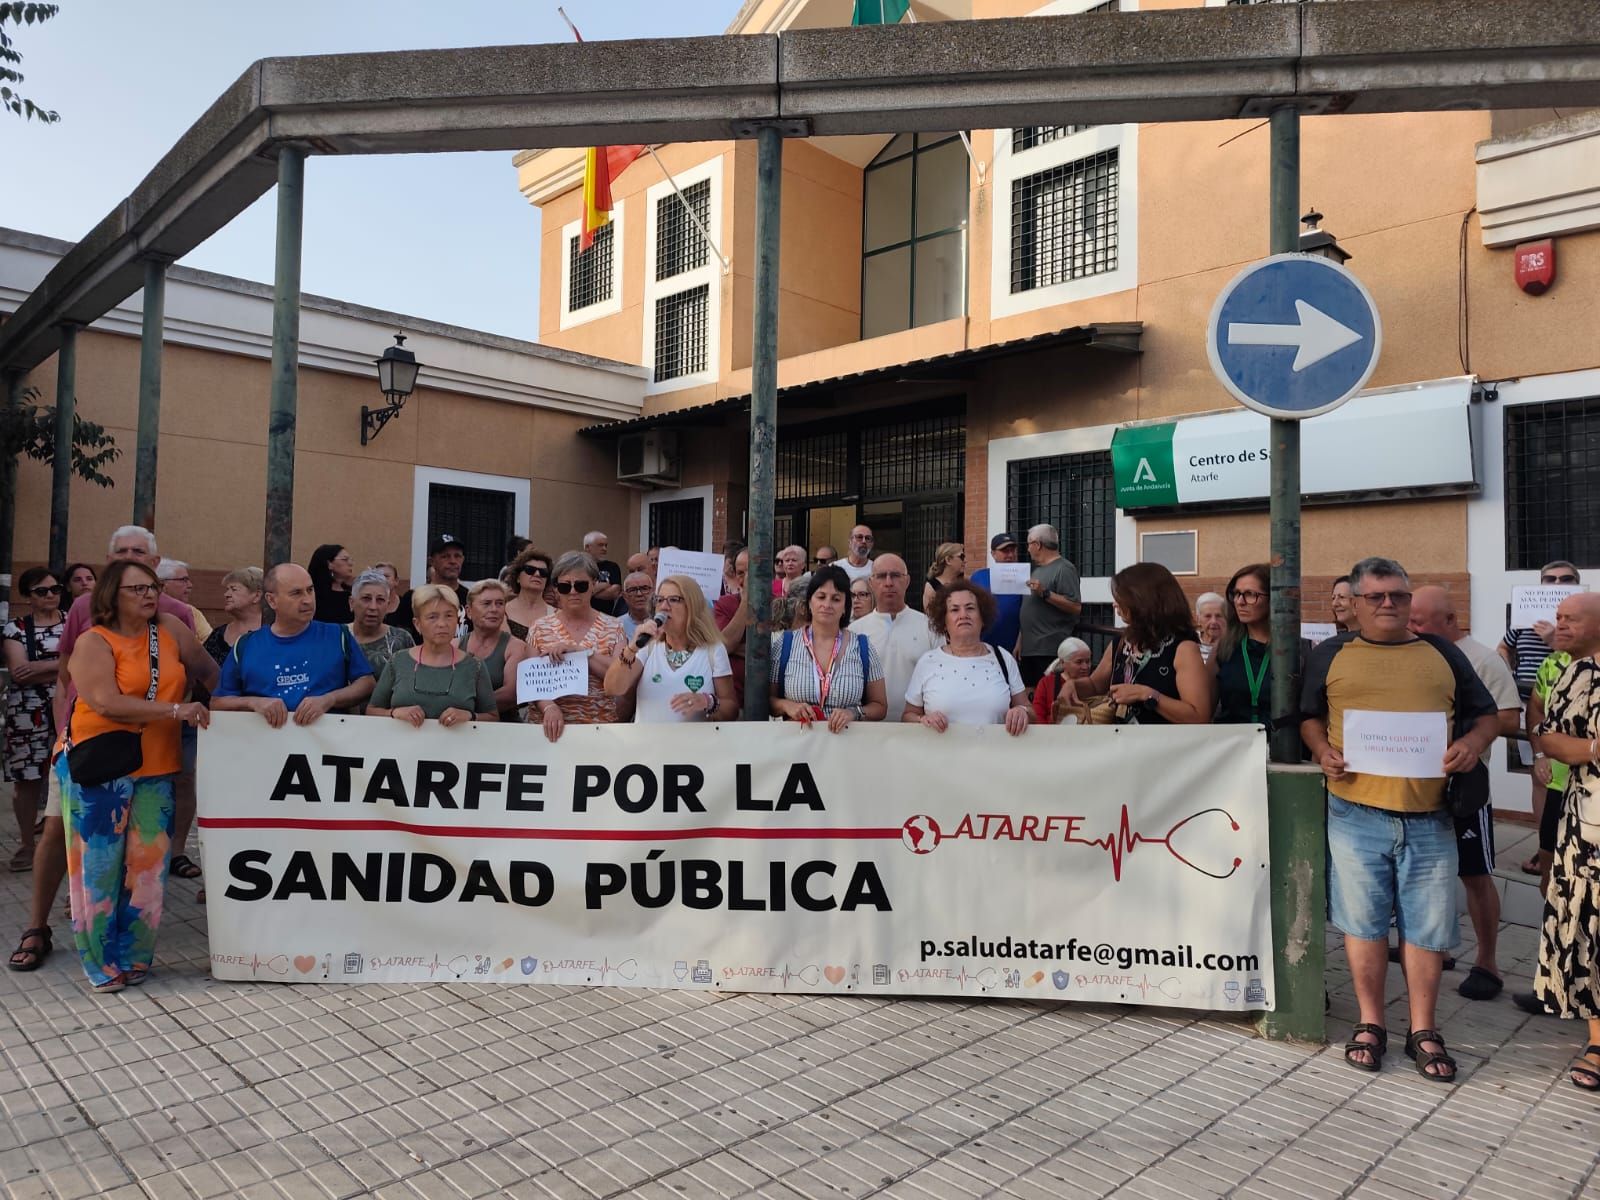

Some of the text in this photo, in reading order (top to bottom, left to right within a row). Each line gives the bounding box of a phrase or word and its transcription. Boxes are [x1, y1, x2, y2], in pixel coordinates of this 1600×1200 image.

[1189, 448, 1271, 467] Centro de S
[1190, 472, 1219, 483] Atarfe
[149, 624, 159, 659] CLASSY
[276, 673, 310, 683] GECOL
[1389, 735, 1419, 743] EQUIPO
[269, 753, 826, 814] ATARFE POR LA
[953, 813, 1086, 842] ATARFE
[224, 849, 893, 912] SANIDAD PÚBLICA
[920, 935, 1260, 972] p.saludatarfe@gmail.com
[210, 954, 1134, 986] ATARFE ATARFE ATARFE ATARFE ATARFE ATARFE
